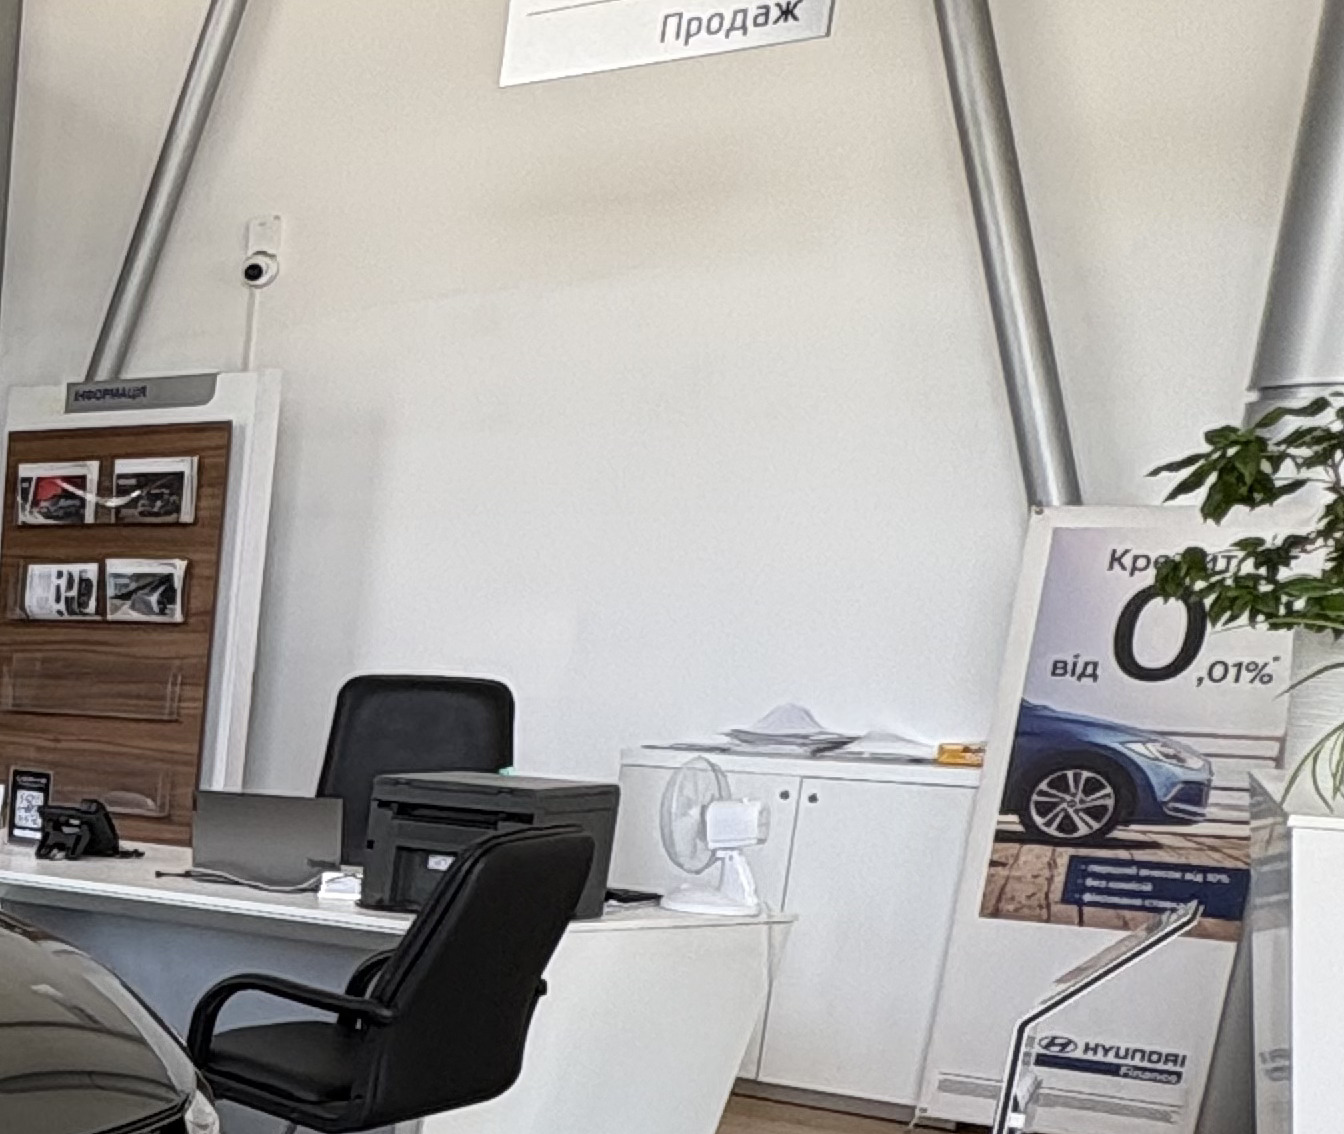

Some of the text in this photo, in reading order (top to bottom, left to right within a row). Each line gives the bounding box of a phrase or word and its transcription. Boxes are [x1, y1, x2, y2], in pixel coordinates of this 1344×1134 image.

[660, 0, 803, 46] Продаж
[1107, 548, 1239, 578] Крит
[1051, 654, 1099, 683] від
[1083, 1041, 1187, 1068] HYUNDAI
